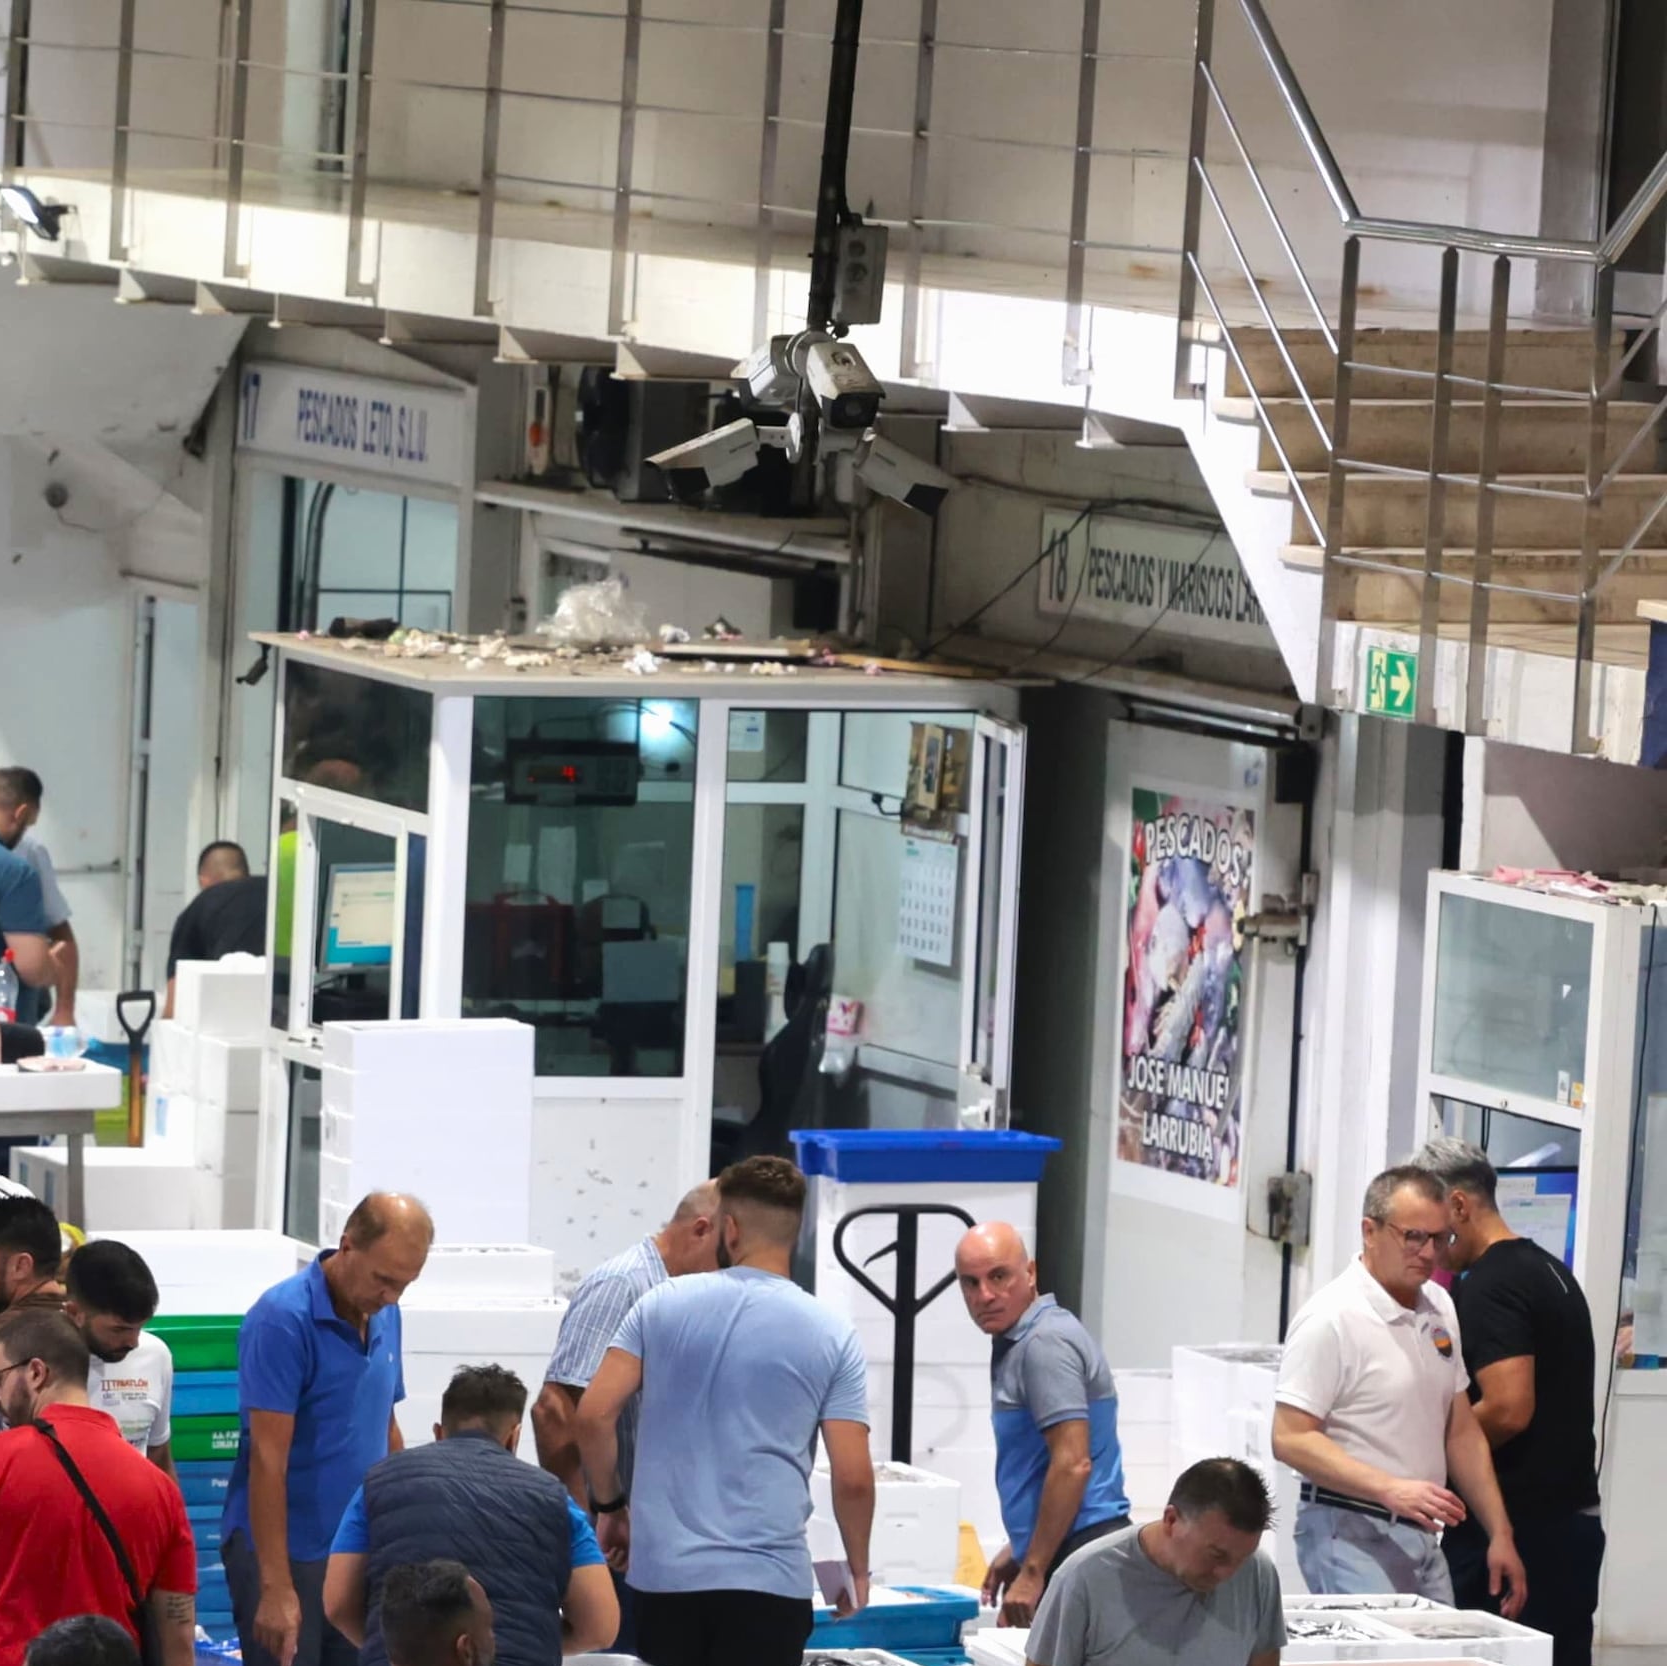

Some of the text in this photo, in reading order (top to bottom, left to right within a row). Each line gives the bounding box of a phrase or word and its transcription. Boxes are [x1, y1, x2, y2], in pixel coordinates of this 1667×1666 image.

[297, 387, 359, 451] PESCADOS
[1048, 526, 1234, 621] 18 PESCADOS Y MARISCOS
[1127, 1052, 1165, 1096] JOSE
[1141, 1110, 1215, 1161] LARRUBIA
